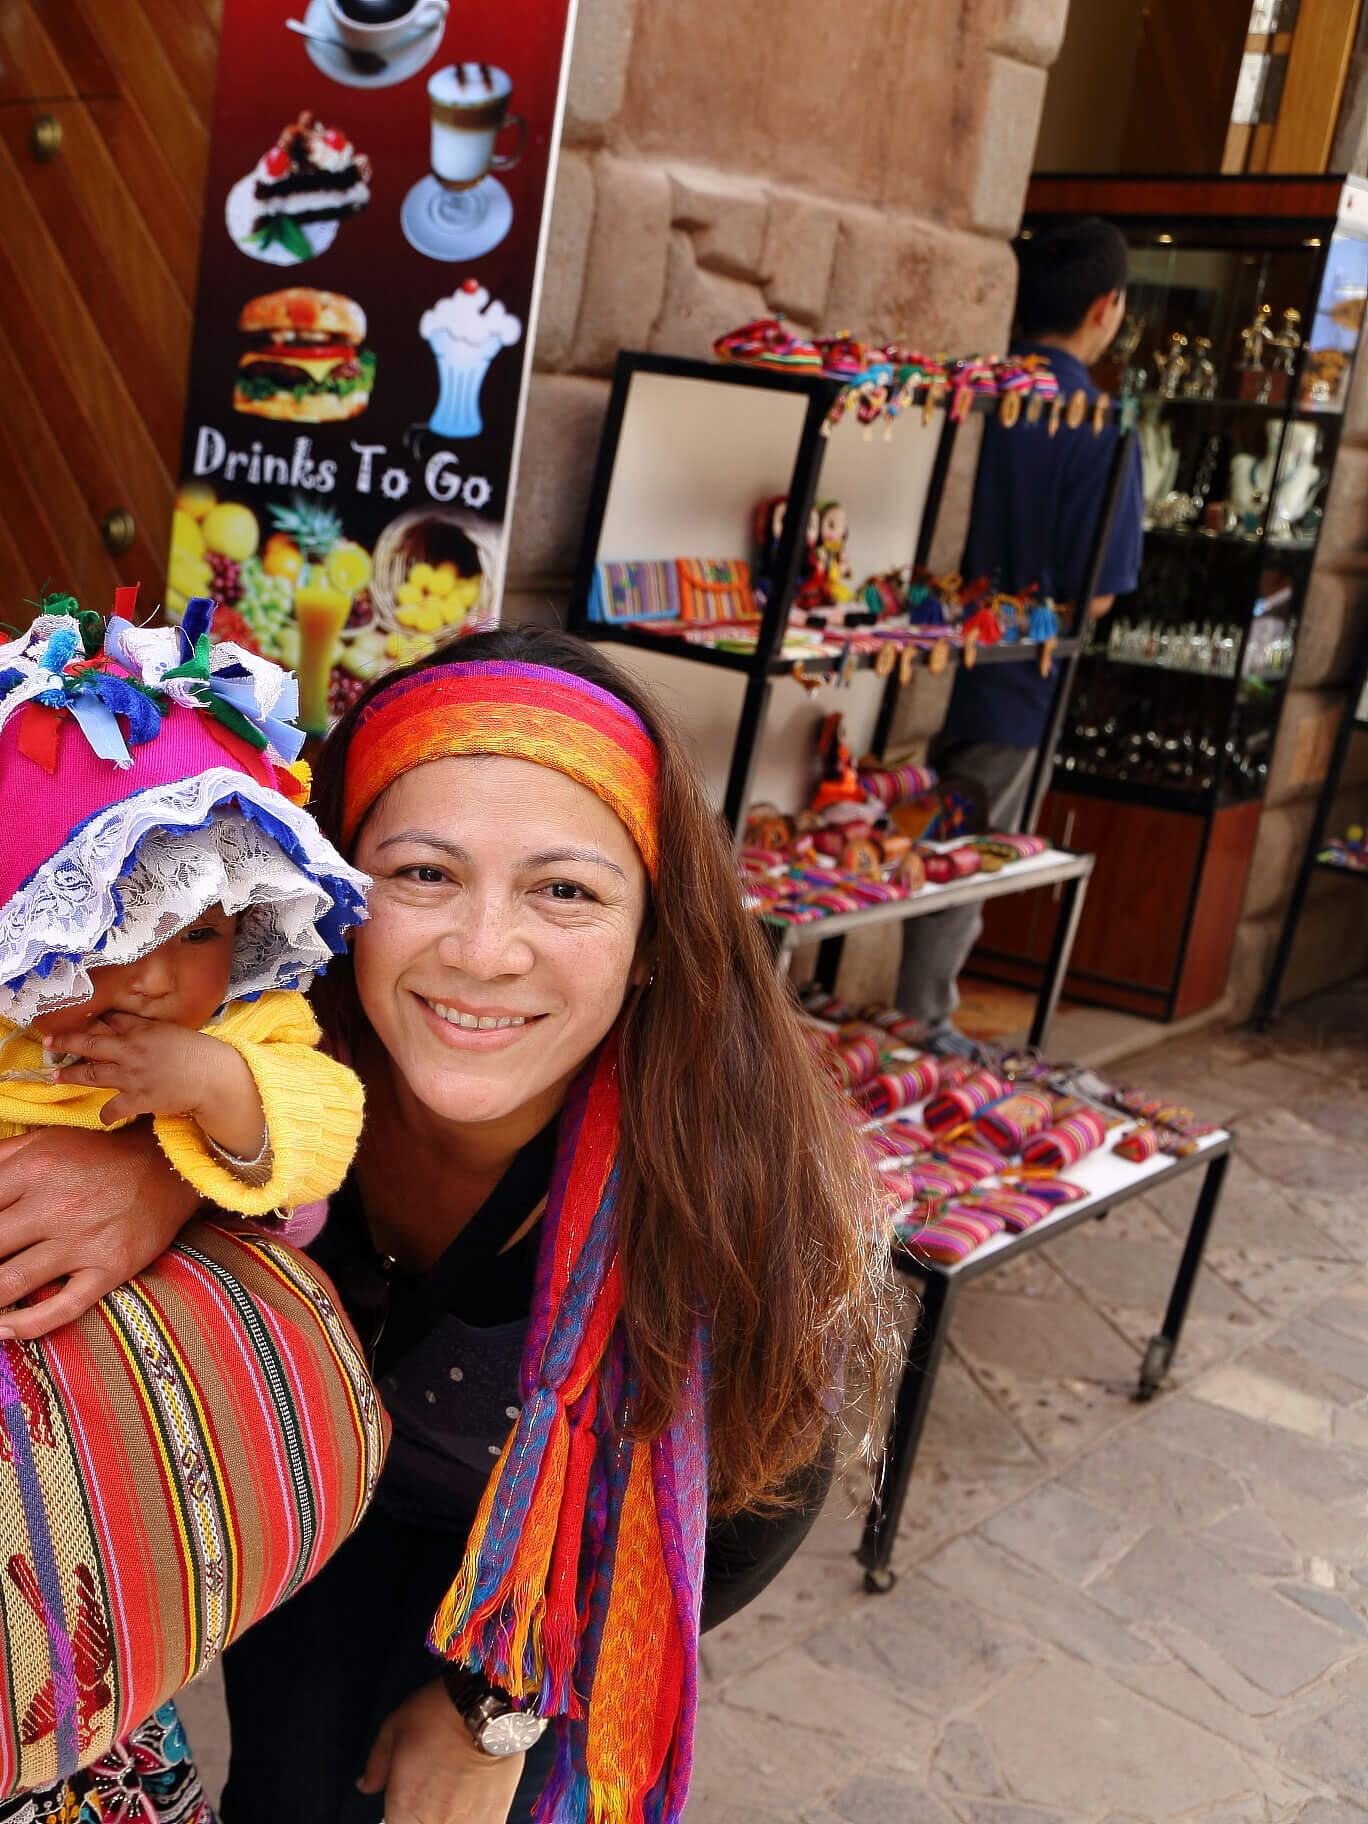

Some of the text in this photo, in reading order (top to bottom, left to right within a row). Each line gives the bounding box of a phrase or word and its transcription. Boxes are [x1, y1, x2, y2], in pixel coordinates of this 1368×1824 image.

[193, 425, 492, 508] Drinks To Go
